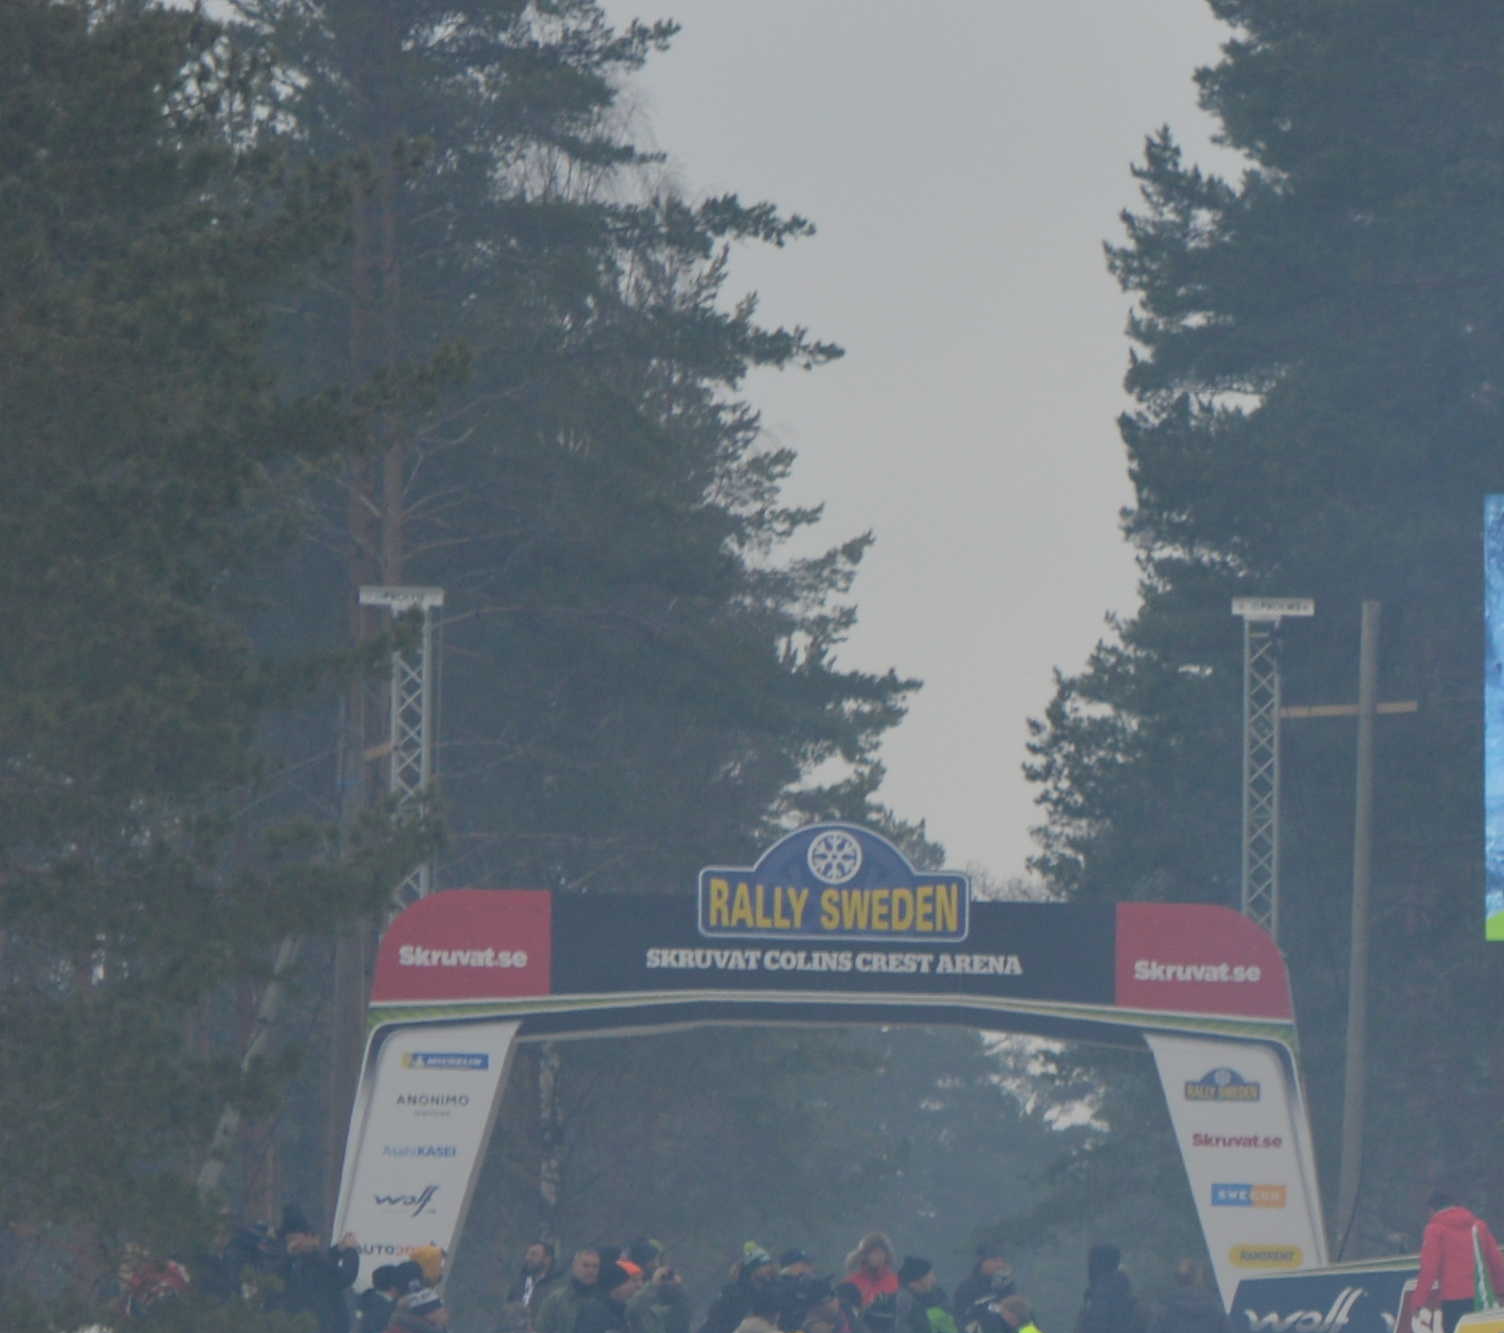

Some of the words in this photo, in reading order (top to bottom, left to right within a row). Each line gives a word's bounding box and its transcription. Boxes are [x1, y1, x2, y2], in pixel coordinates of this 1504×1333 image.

[709, 878, 808, 929] RALLY
[820, 882, 958, 933] SWEDEN
[400, 943, 528, 969] Skruvat.se
[646, 948, 761, 971] SKRUVAT
[764, 949, 851, 972] COLINS
[855, 952, 934, 973] CREST
[937, 954, 1022, 976] ARENA
[1134, 959, 1262, 983] Skruvat.se
[396, 1094, 470, 1106] ANONIMO
[1192, 1133, 1283, 1149] Skruvat.se
